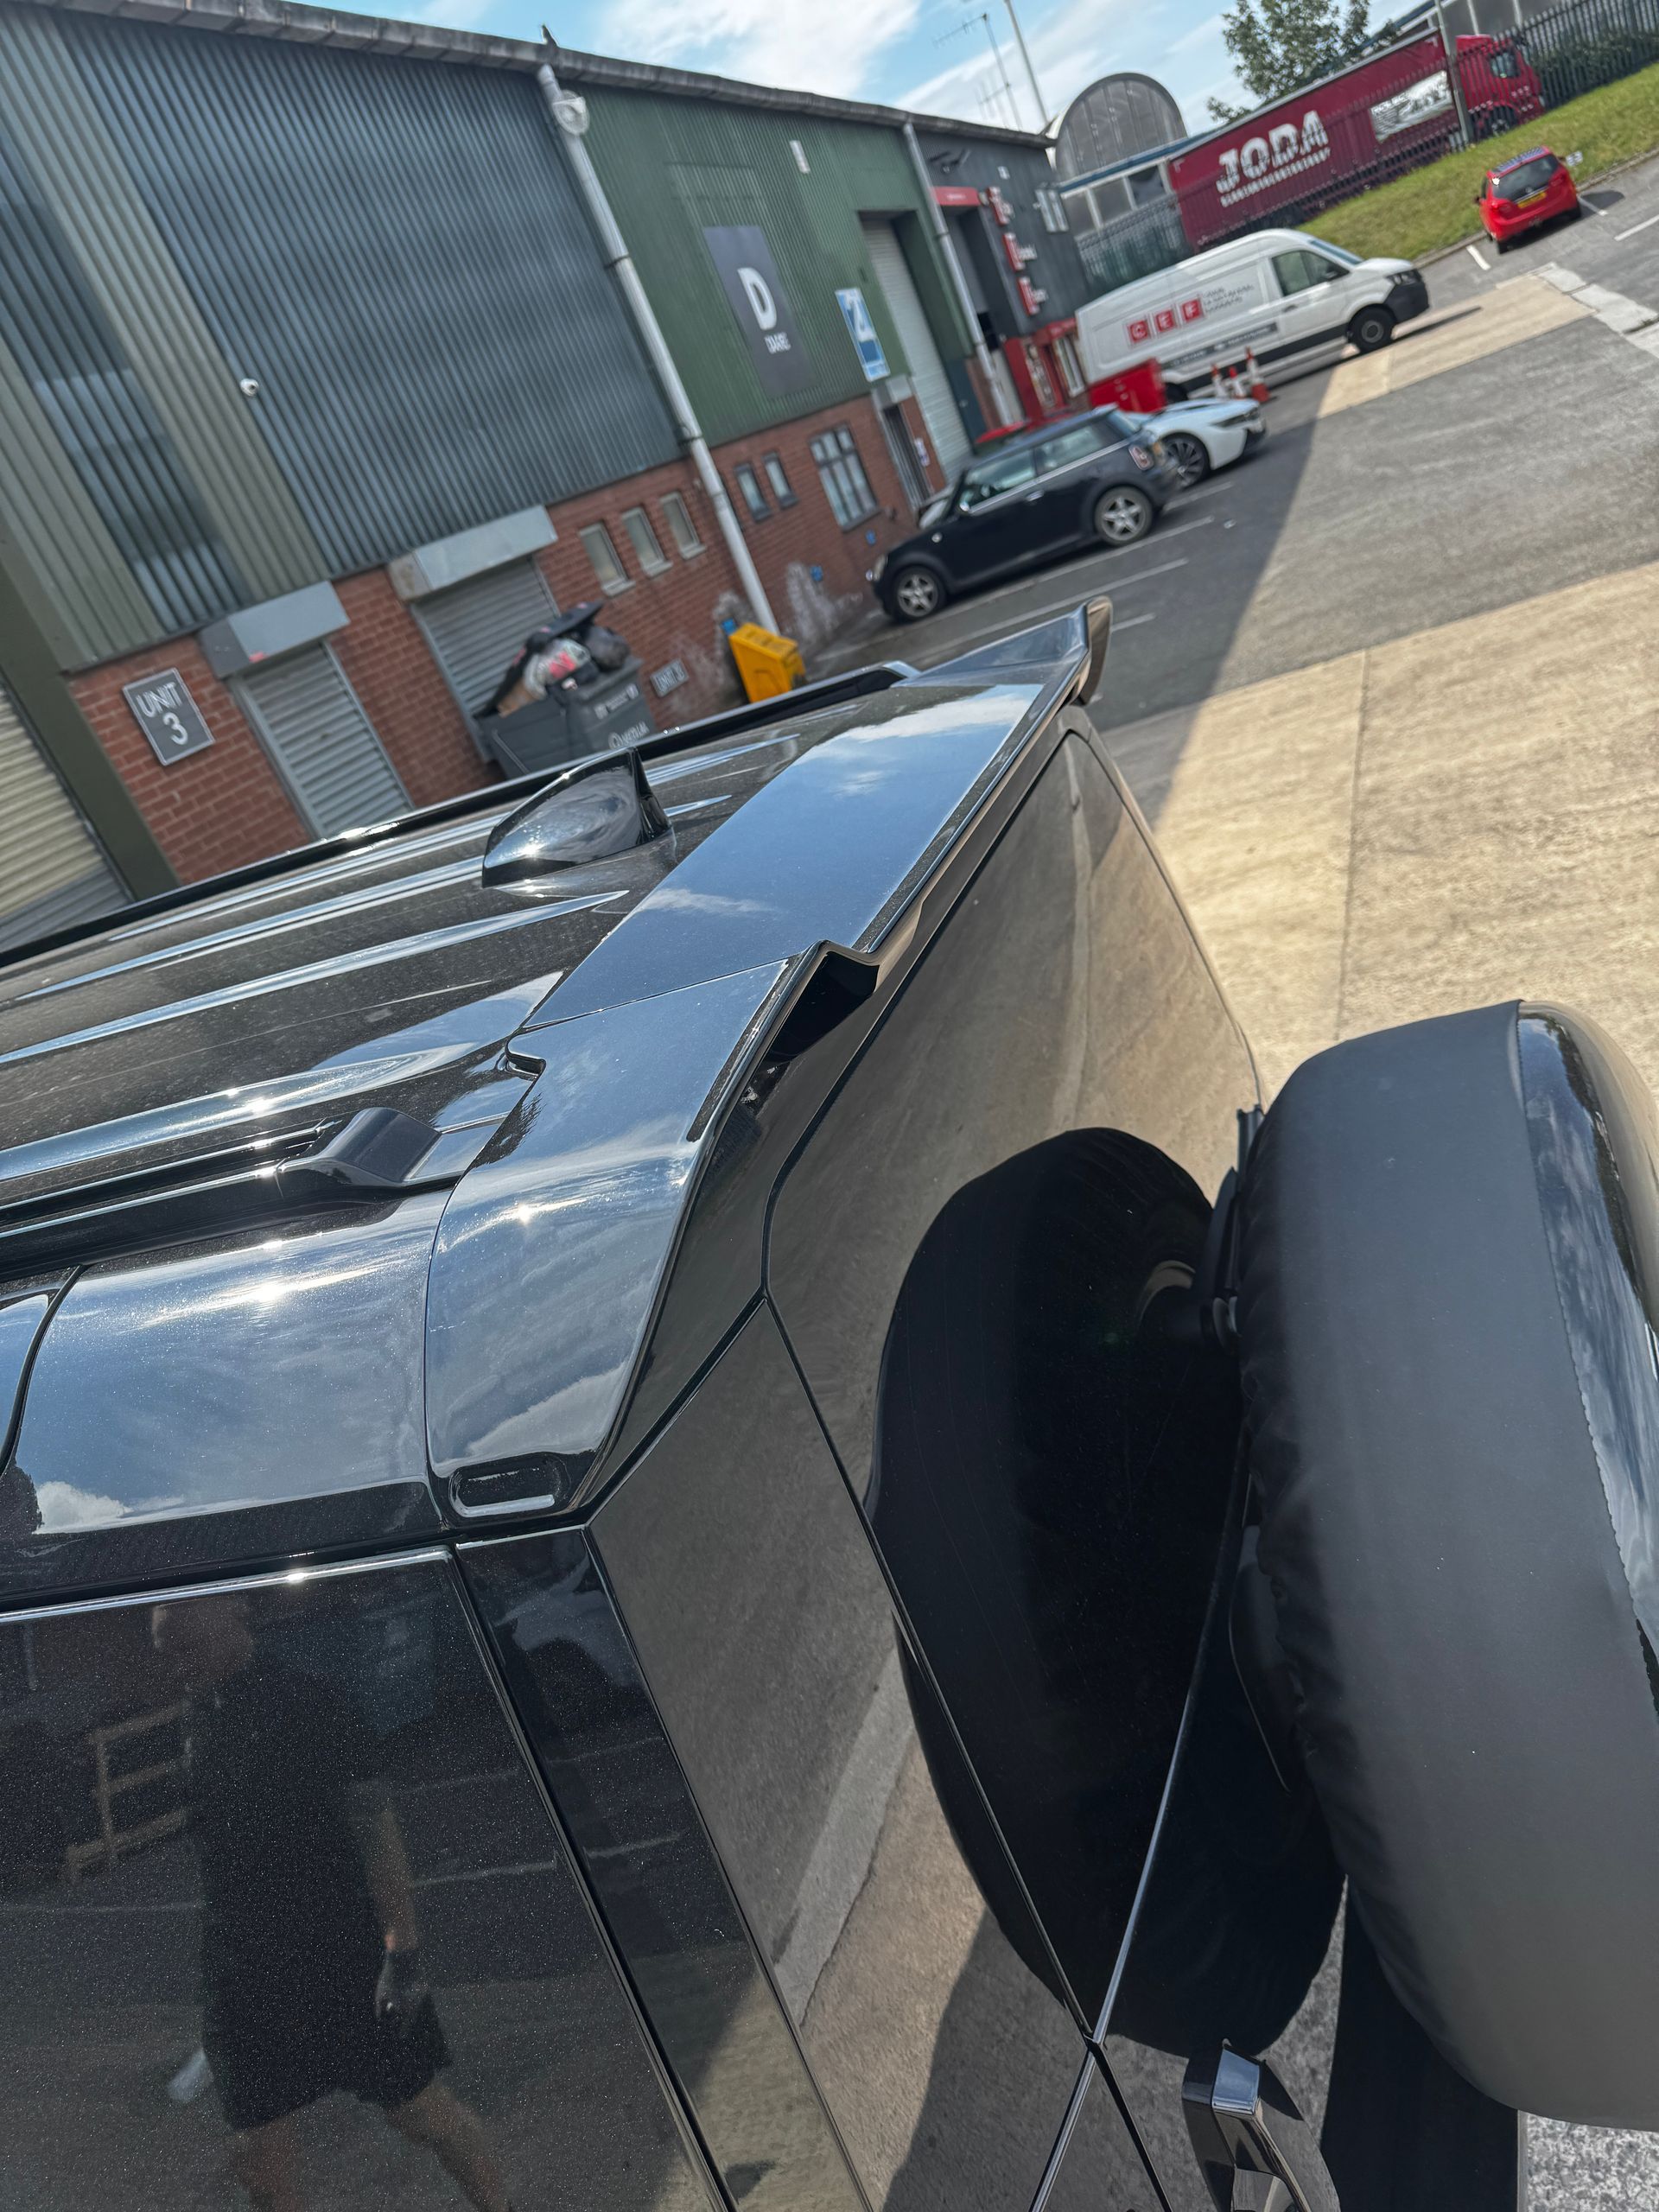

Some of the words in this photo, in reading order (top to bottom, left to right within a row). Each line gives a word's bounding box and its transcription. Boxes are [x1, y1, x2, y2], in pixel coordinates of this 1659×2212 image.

[1215, 110, 1329, 194] JODA
[737, 267, 777, 330] D
[135, 681, 182, 718] UNIT
[162, 712, 188, 745] 3
